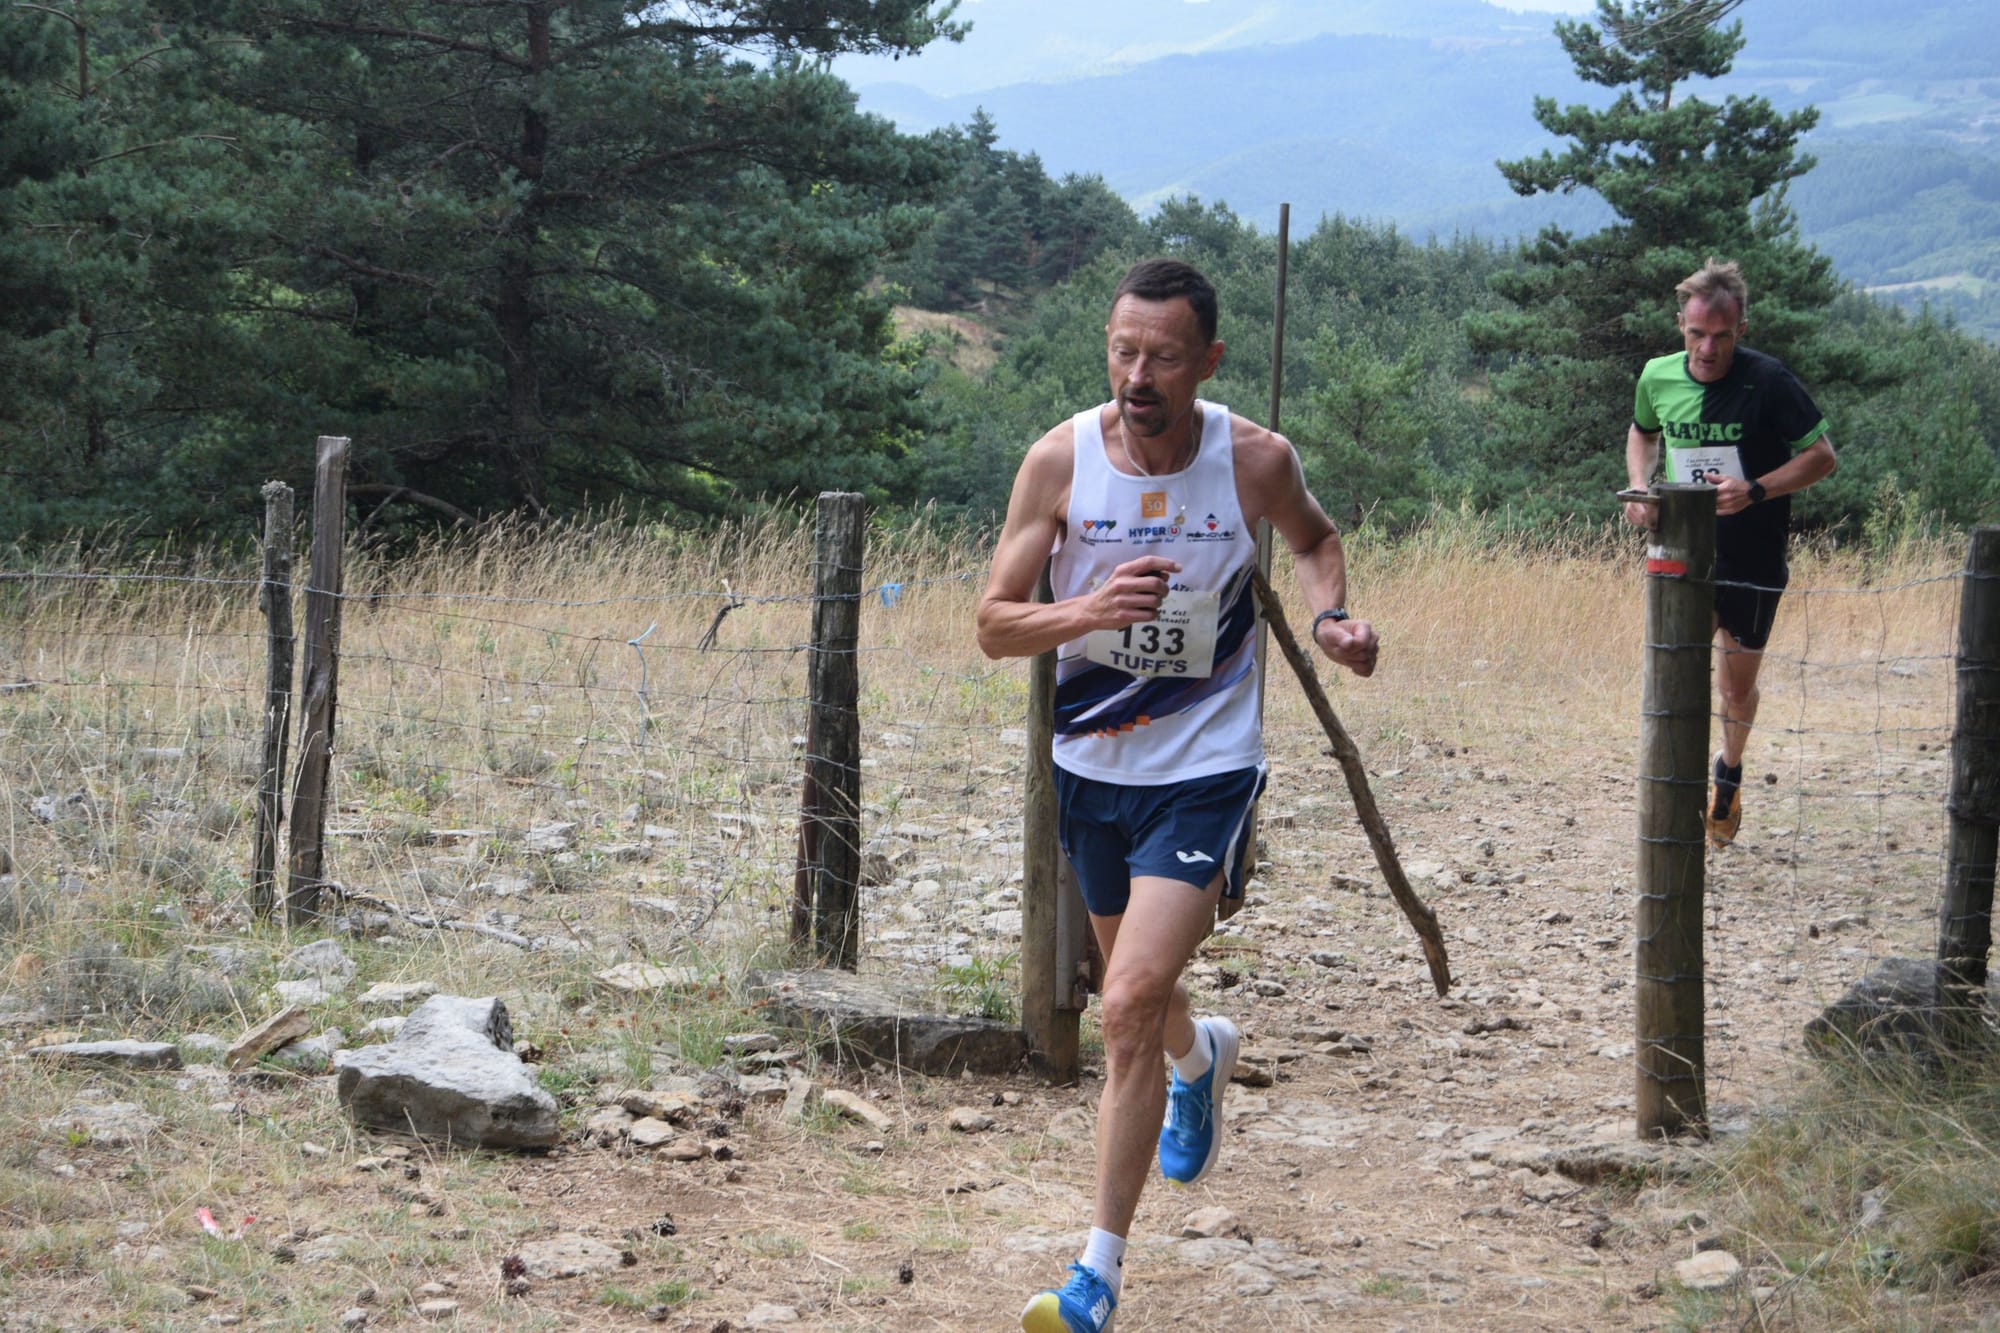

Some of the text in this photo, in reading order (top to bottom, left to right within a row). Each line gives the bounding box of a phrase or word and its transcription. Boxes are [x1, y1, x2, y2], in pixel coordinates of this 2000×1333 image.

[1129, 527, 1166, 537] HYPER
[1118, 624, 1185, 655] 133
[1110, 650, 1188, 673] TUFF'S
